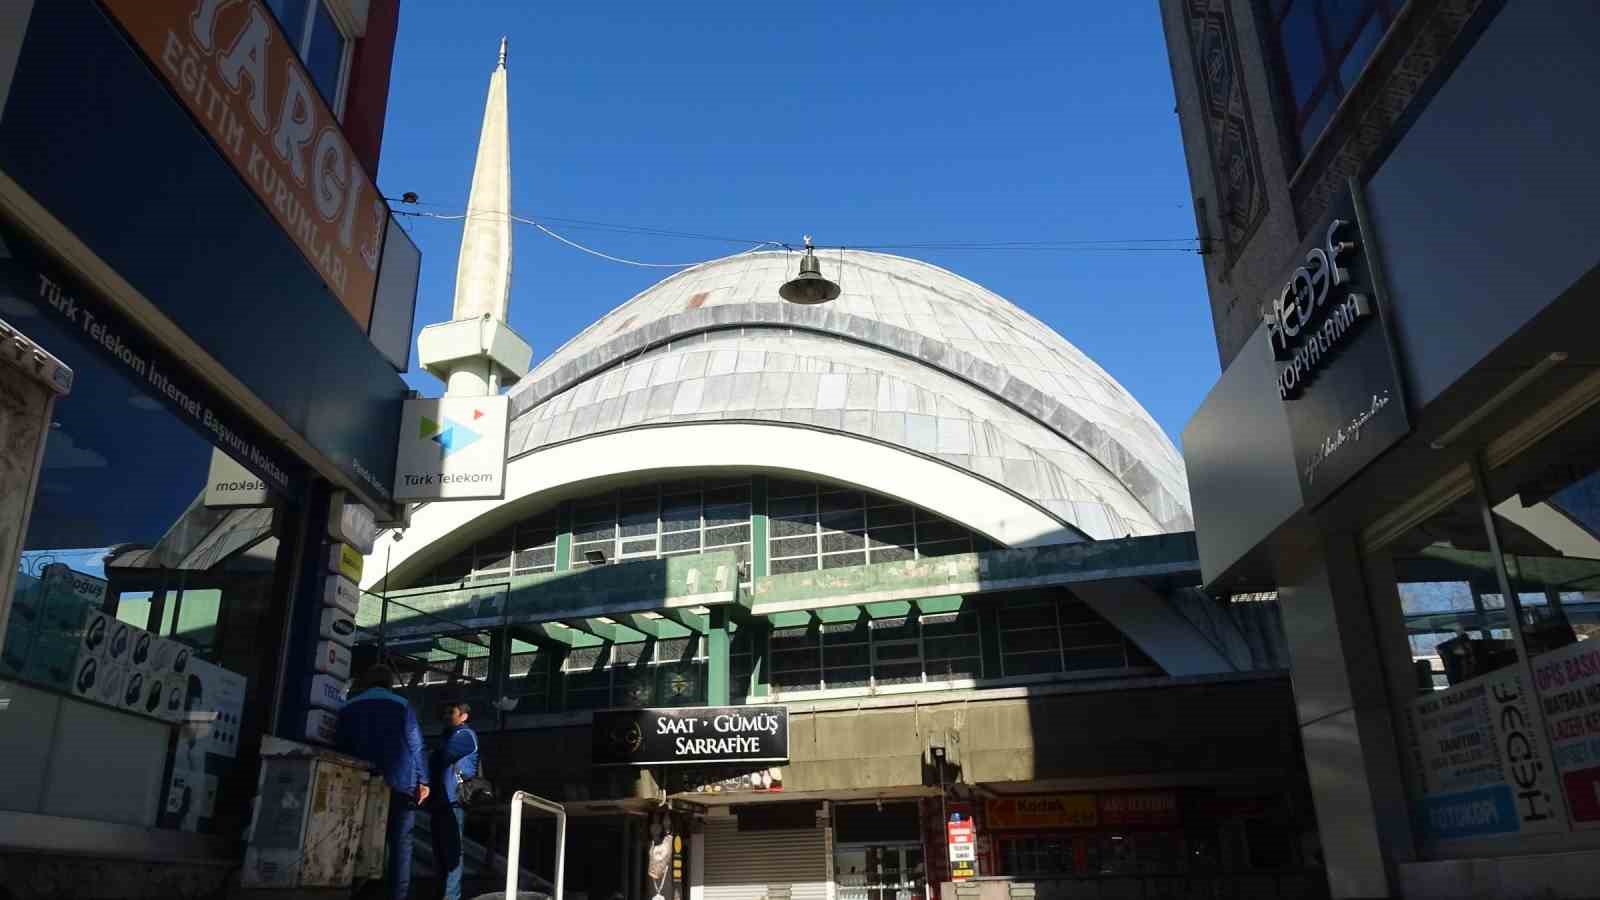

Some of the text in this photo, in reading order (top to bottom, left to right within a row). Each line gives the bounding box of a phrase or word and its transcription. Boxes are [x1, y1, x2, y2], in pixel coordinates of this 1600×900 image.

[160, 27, 348, 294] EĞİTİM KURUMLARI
[38, 272, 79, 323] Türk
[82, 309, 146, 377] Telekom
[148, 360, 202, 420] İnternet
[203, 407, 254, 457] Başvuru
[1276, 292, 1362, 400] KOPYALAMA
[404, 471, 493, 487] Türk Telekom
[656, 713, 779, 736] SAAT GÜMÜŞ
[674, 735, 761, 755] SARRAFİYE
